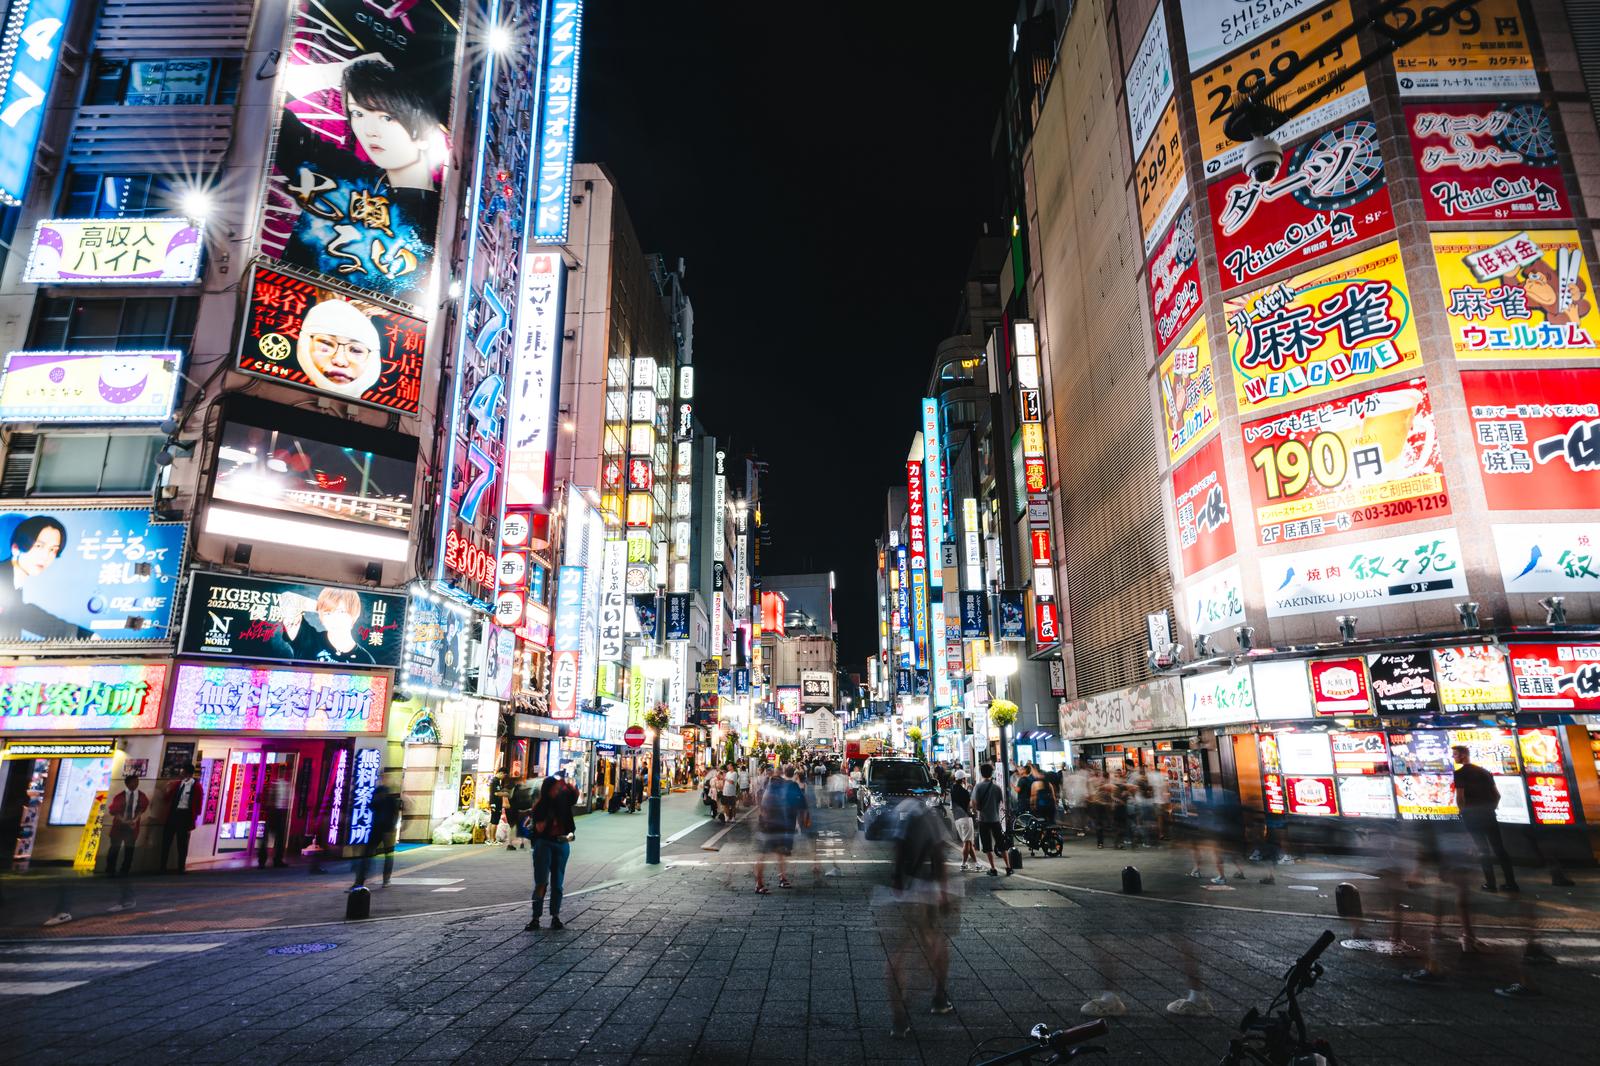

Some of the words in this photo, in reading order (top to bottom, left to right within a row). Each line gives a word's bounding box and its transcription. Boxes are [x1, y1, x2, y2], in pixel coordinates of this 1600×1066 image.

[1494, 16, 1520, 36] 円
[1397, 57, 1438, 68] 生ビール
[1488, 56, 1529, 66] カクテル
[1442, 77, 1474, 88] 九十九
[1414, 112, 1510, 137] ダイニング
[540, 74, 573, 228] カラオケランド
[1452, 134, 1468, 148] &
[1140, 143, 1167, 209] 299
[1169, 132, 1180, 157] 円
[1420, 148, 1522, 171] ダーツバー
[1218, 142, 1360, 238] ダーツ
[79, 226, 155, 249] 高収入
[1477, 239, 1538, 276] 低料金
[1228, 280, 1297, 337] フリー&セット
[1449, 286, 1531, 320] 麻雀
[276, 315, 303, 339] 麦
[1241, 282, 1398, 368] 麻雀
[1463, 323, 1592, 348] ウェルカム
[379, 323, 401, 393] オープン
[396, 329, 425, 402] 新店舗
[1244, 342, 1396, 402] WELCOME
[1185, 364, 1214, 409] 麻雀
[1027, 391, 1038, 416] ダーツ
[1171, 405, 1213, 451] ウェルカム
[1245, 394, 1382, 443] いつでも生ビールが
[1479, 422, 1527, 443] 居酒屋
[1251, 431, 1349, 500] 190
[1353, 446, 1384, 480] 円
[1485, 451, 1531, 471] 焼鳥
[1027, 464, 1045, 490] 麻雀
[908, 463, 927, 553] カラオケ歌広場
[1262, 527, 1281, 544] 2F
[1284, 514, 1351, 540] 居酒屋一休
[1364, 493, 1449, 522] 03-3200-1219
[504, 521, 520, 537] 売
[77, 536, 169, 562] モテるって
[1306, 566, 1341, 582] 焼肉
[1348, 539, 1458, 581] 叙々苑
[501, 561, 516, 576] 香
[498, 600, 513, 615] 煙
[560, 568, 584, 650] カラオケ
[1276, 593, 1337, 609] YAKINIKU
[1337, 588, 1384, 604] JOJOEN
[1409, 583, 1430, 594] 9F
[601, 591, 622, 657] にいむら
[205, 636, 231, 646] NORN
[1438, 651, 1458, 683] 九十九
[193, 680, 375, 721] 無料案内所
[1461, 688, 1485, 699] 299
[1518, 677, 1556, 695] 居酒屋
[1355, 735, 1382, 752] 一休
[349, 749, 381, 846] 無料案内所
